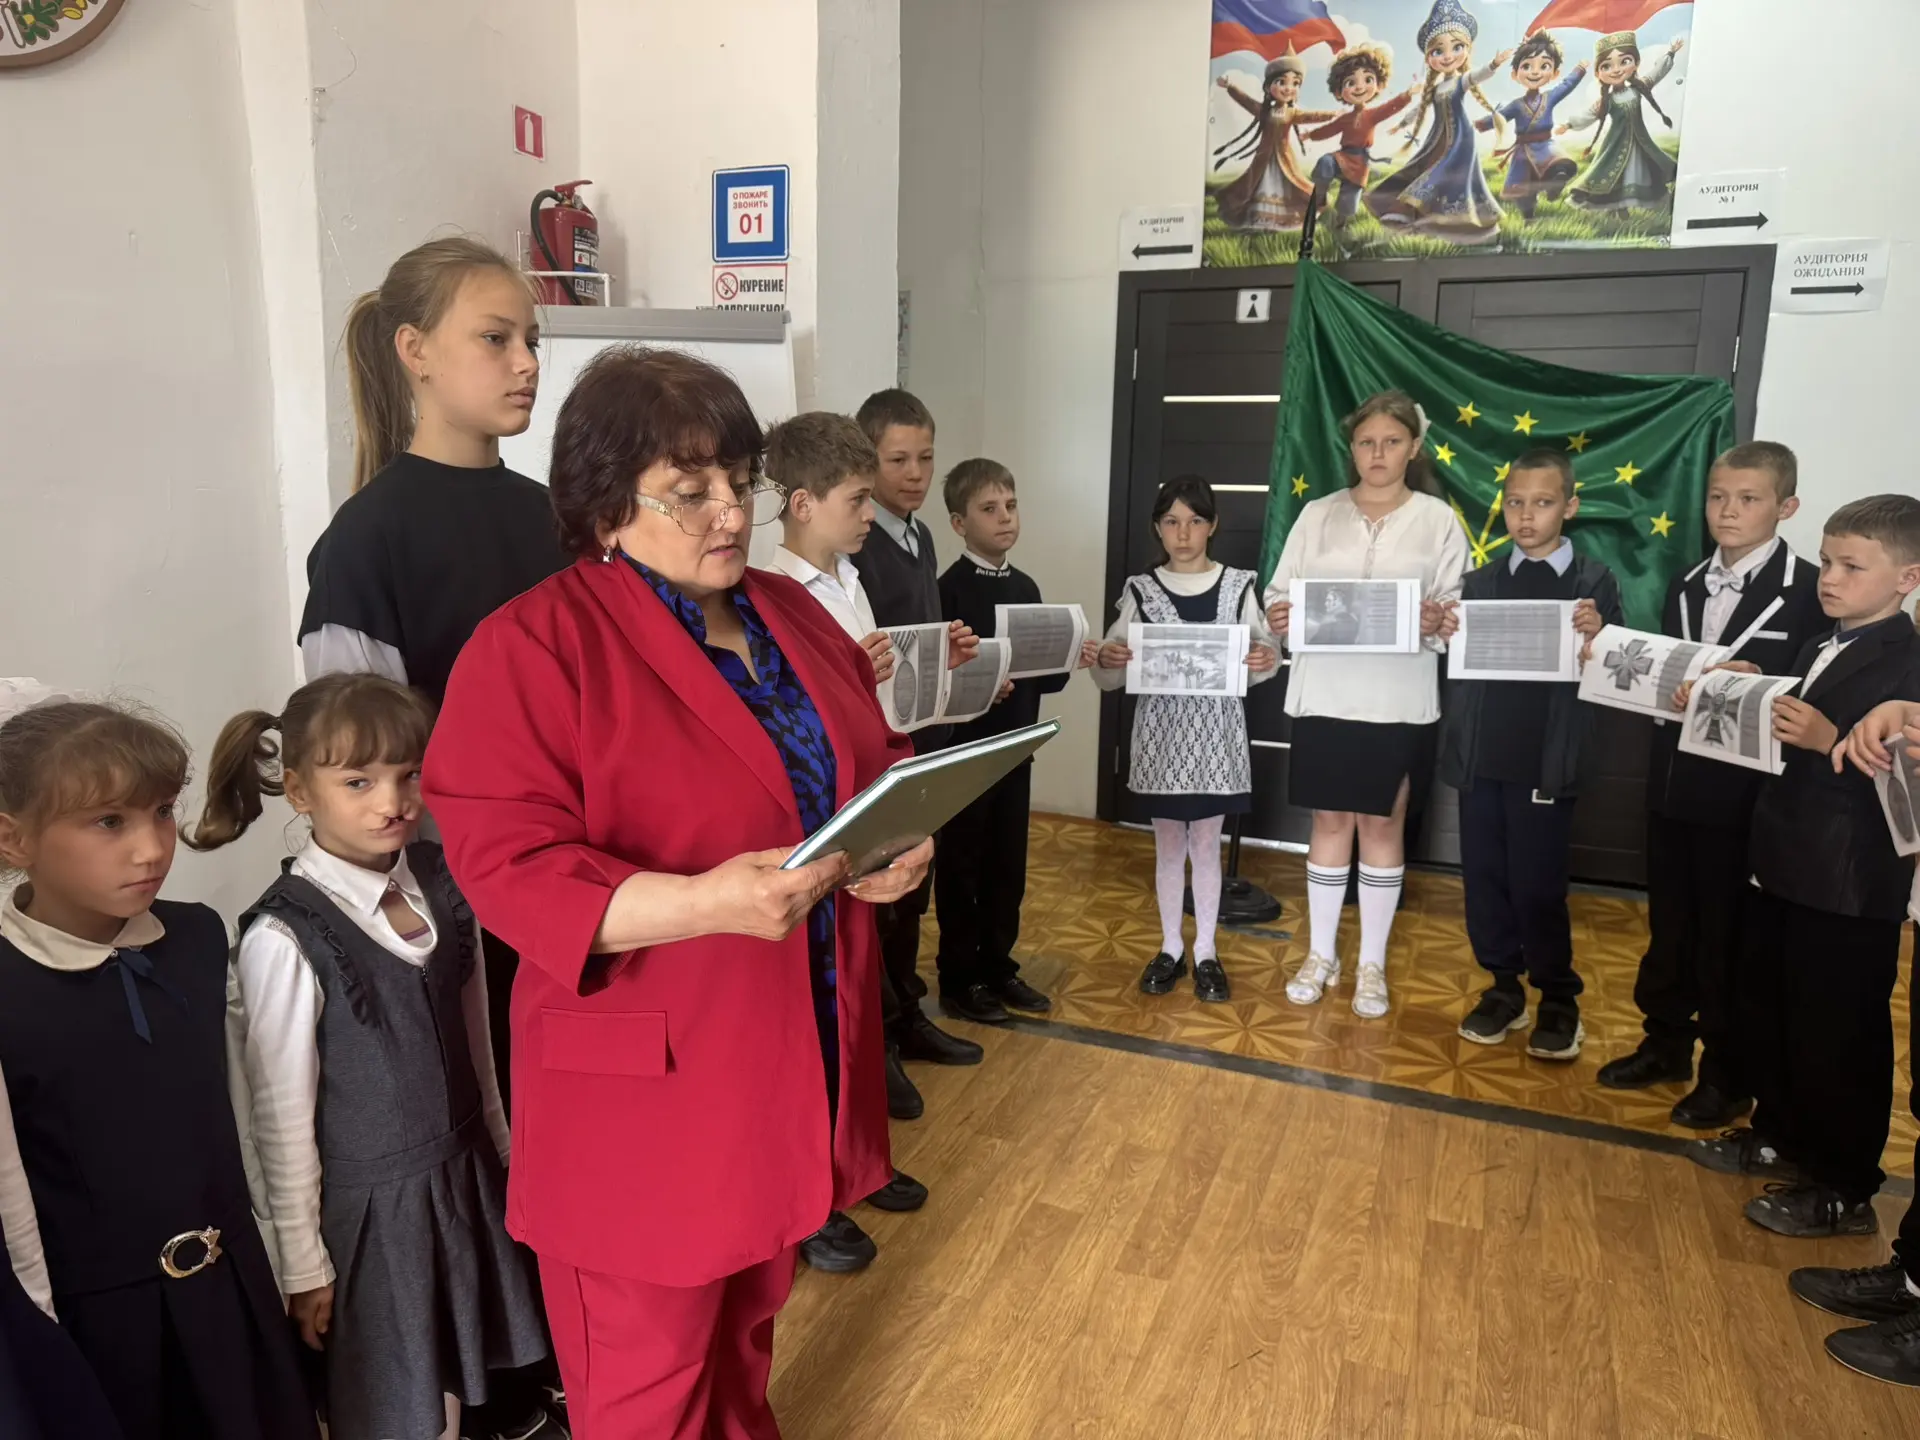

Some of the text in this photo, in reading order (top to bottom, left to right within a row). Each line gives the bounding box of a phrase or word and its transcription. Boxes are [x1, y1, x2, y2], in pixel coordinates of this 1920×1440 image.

[739, 191, 768, 199] ПОЖАРЕ
[1699, 184, 1759, 195] АУДИТОРИЯ
[733, 200, 768, 209] ЗВОНИТЬ
[1718, 196, 1728, 204] №
[740, 213, 762, 234] 01
[1794, 253, 1869, 266] АУДИТОРИЯ
[1794, 266, 1865, 278] ОЖИДАНИЯ
[740, 279, 784, 292] КУРЕНИЕ
